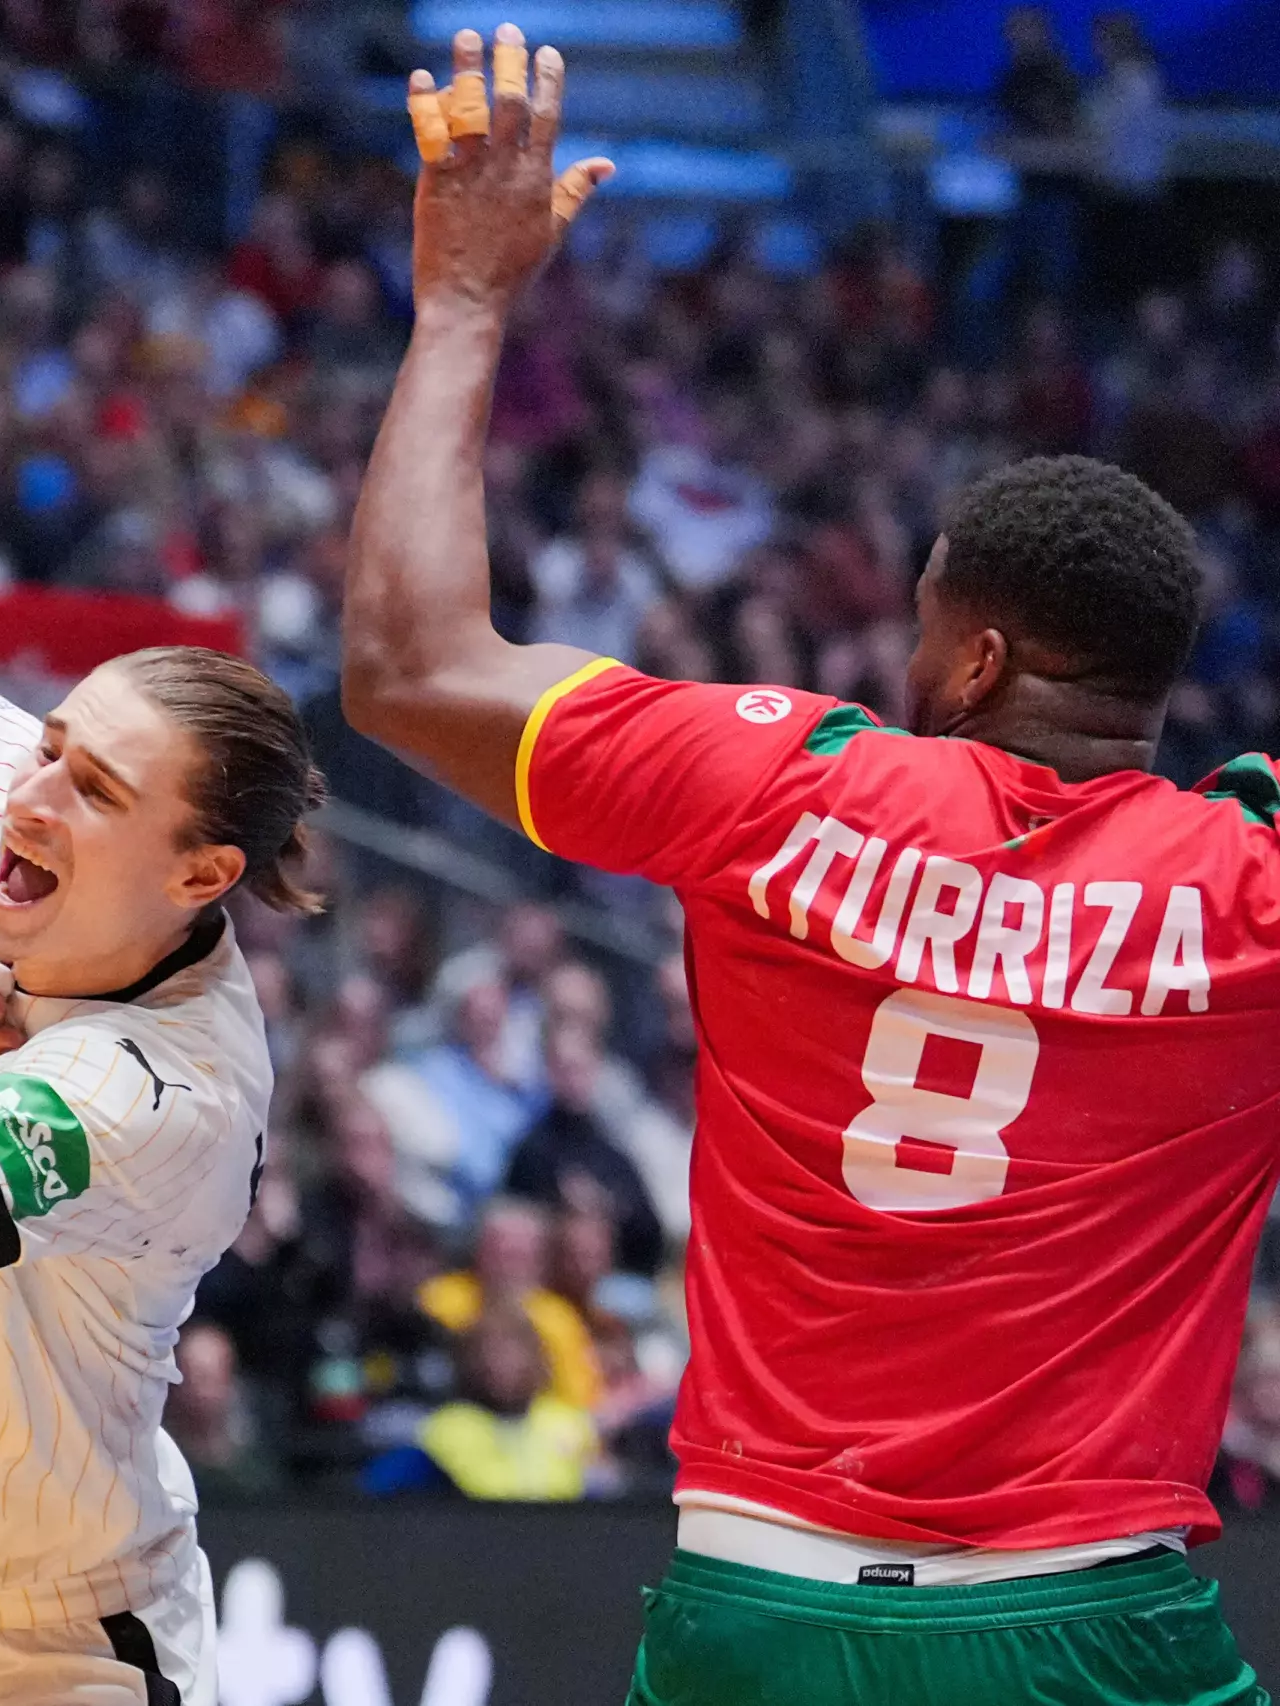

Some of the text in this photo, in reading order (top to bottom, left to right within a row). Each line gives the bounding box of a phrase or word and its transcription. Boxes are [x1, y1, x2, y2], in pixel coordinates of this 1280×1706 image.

[748, 811, 1211, 1015] ITURRIZA
[841, 987, 1040, 1211] 8
[863, 1567, 910, 1582] Kempa
